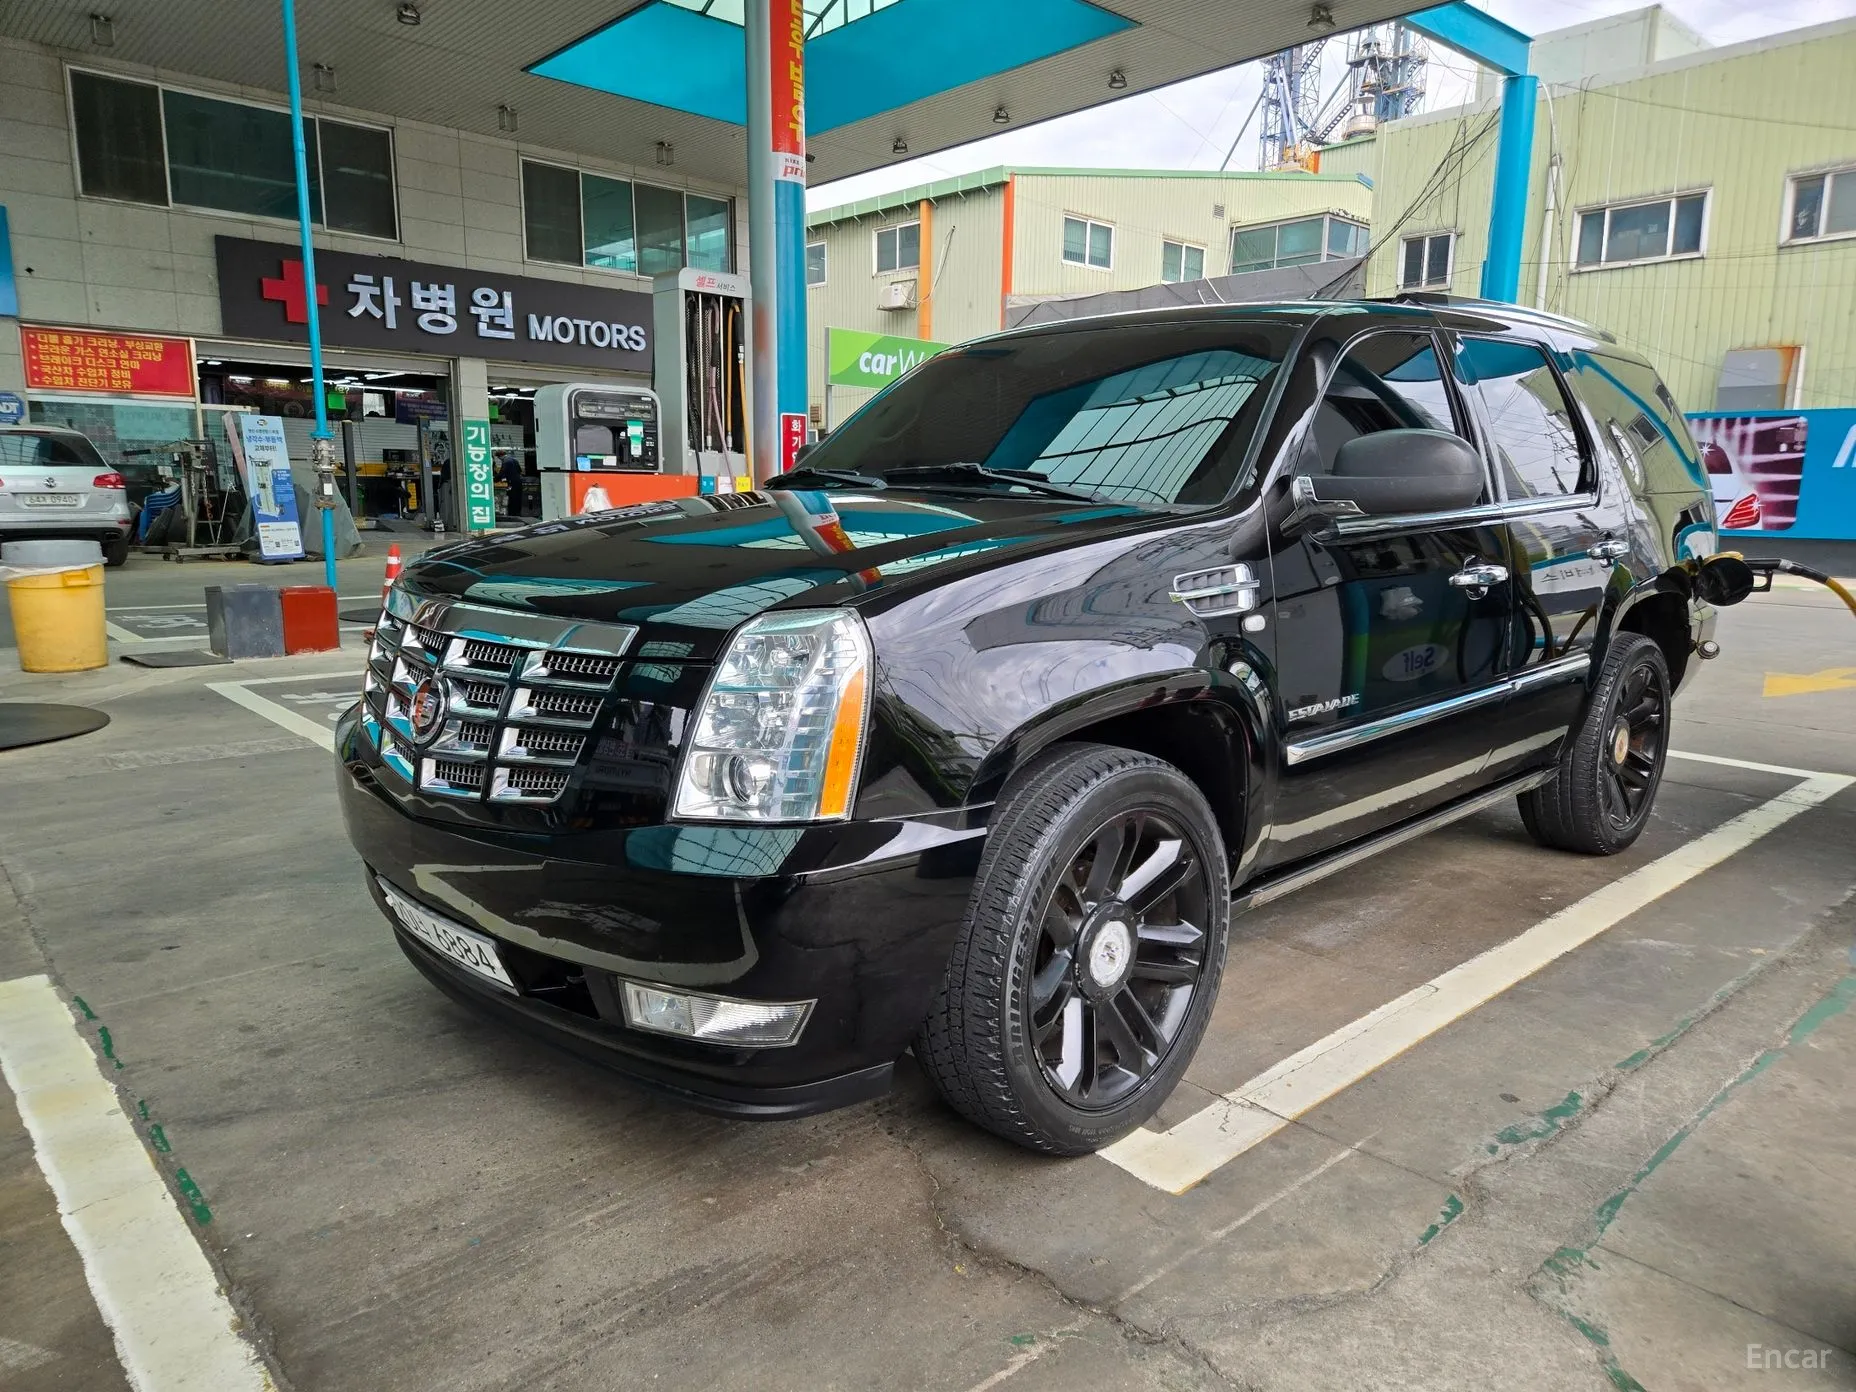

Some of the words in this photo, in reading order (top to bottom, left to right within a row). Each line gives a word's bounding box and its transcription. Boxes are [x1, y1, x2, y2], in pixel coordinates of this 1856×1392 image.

[696, 275, 717, 288] 셀프
[716, 281, 737, 292] 서비스
[347, 272, 516, 341] 차병원
[527, 313, 648, 352] MOTORS
[85, 357, 117, 369] 디스크
[432, 922, 497, 975] 6884
